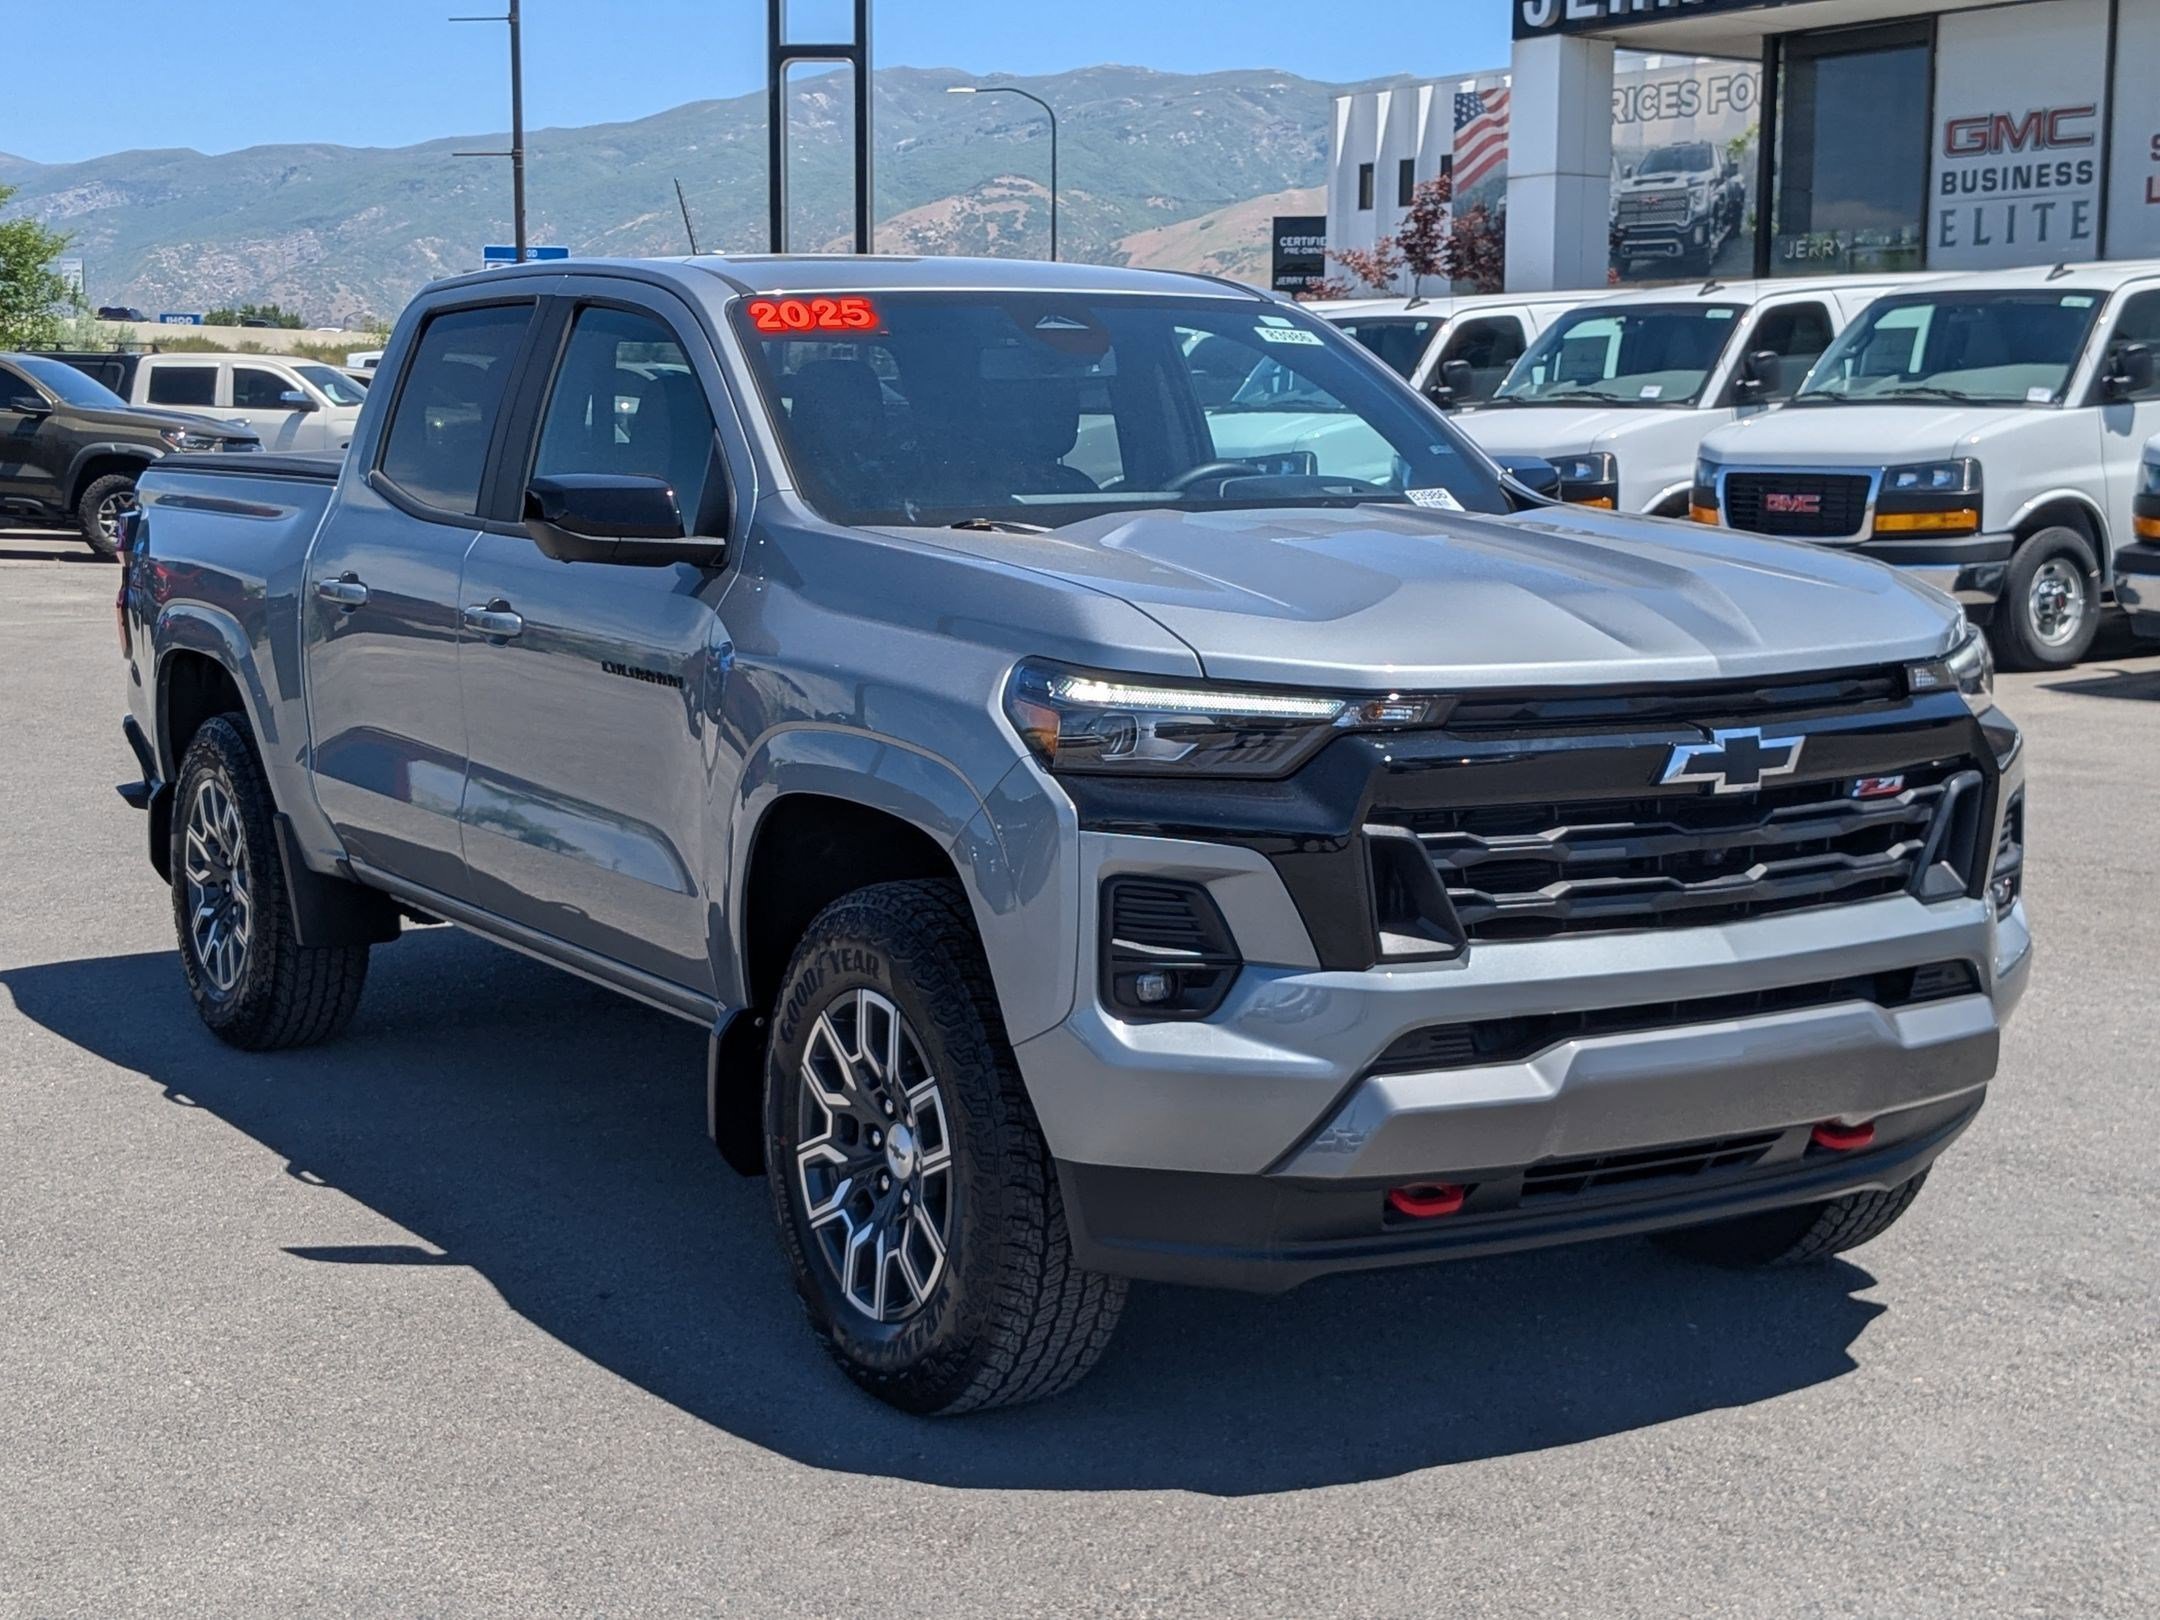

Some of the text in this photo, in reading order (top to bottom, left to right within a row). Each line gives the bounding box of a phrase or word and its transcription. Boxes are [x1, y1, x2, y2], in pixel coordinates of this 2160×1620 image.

[1612, 79, 1701, 124] RICES
[1943, 103, 2096, 158] GMC
[1940, 159, 2093, 196] BUSINESS
[1938, 200, 2090, 248] ELITE
[526, 249, 538, 258] OD
[1279, 235, 1328, 247] CERTIFIE
[1784, 237, 1846, 259] JERRY
[749, 298, 876, 331] 2025
[1765, 493, 1821, 512] GMC
